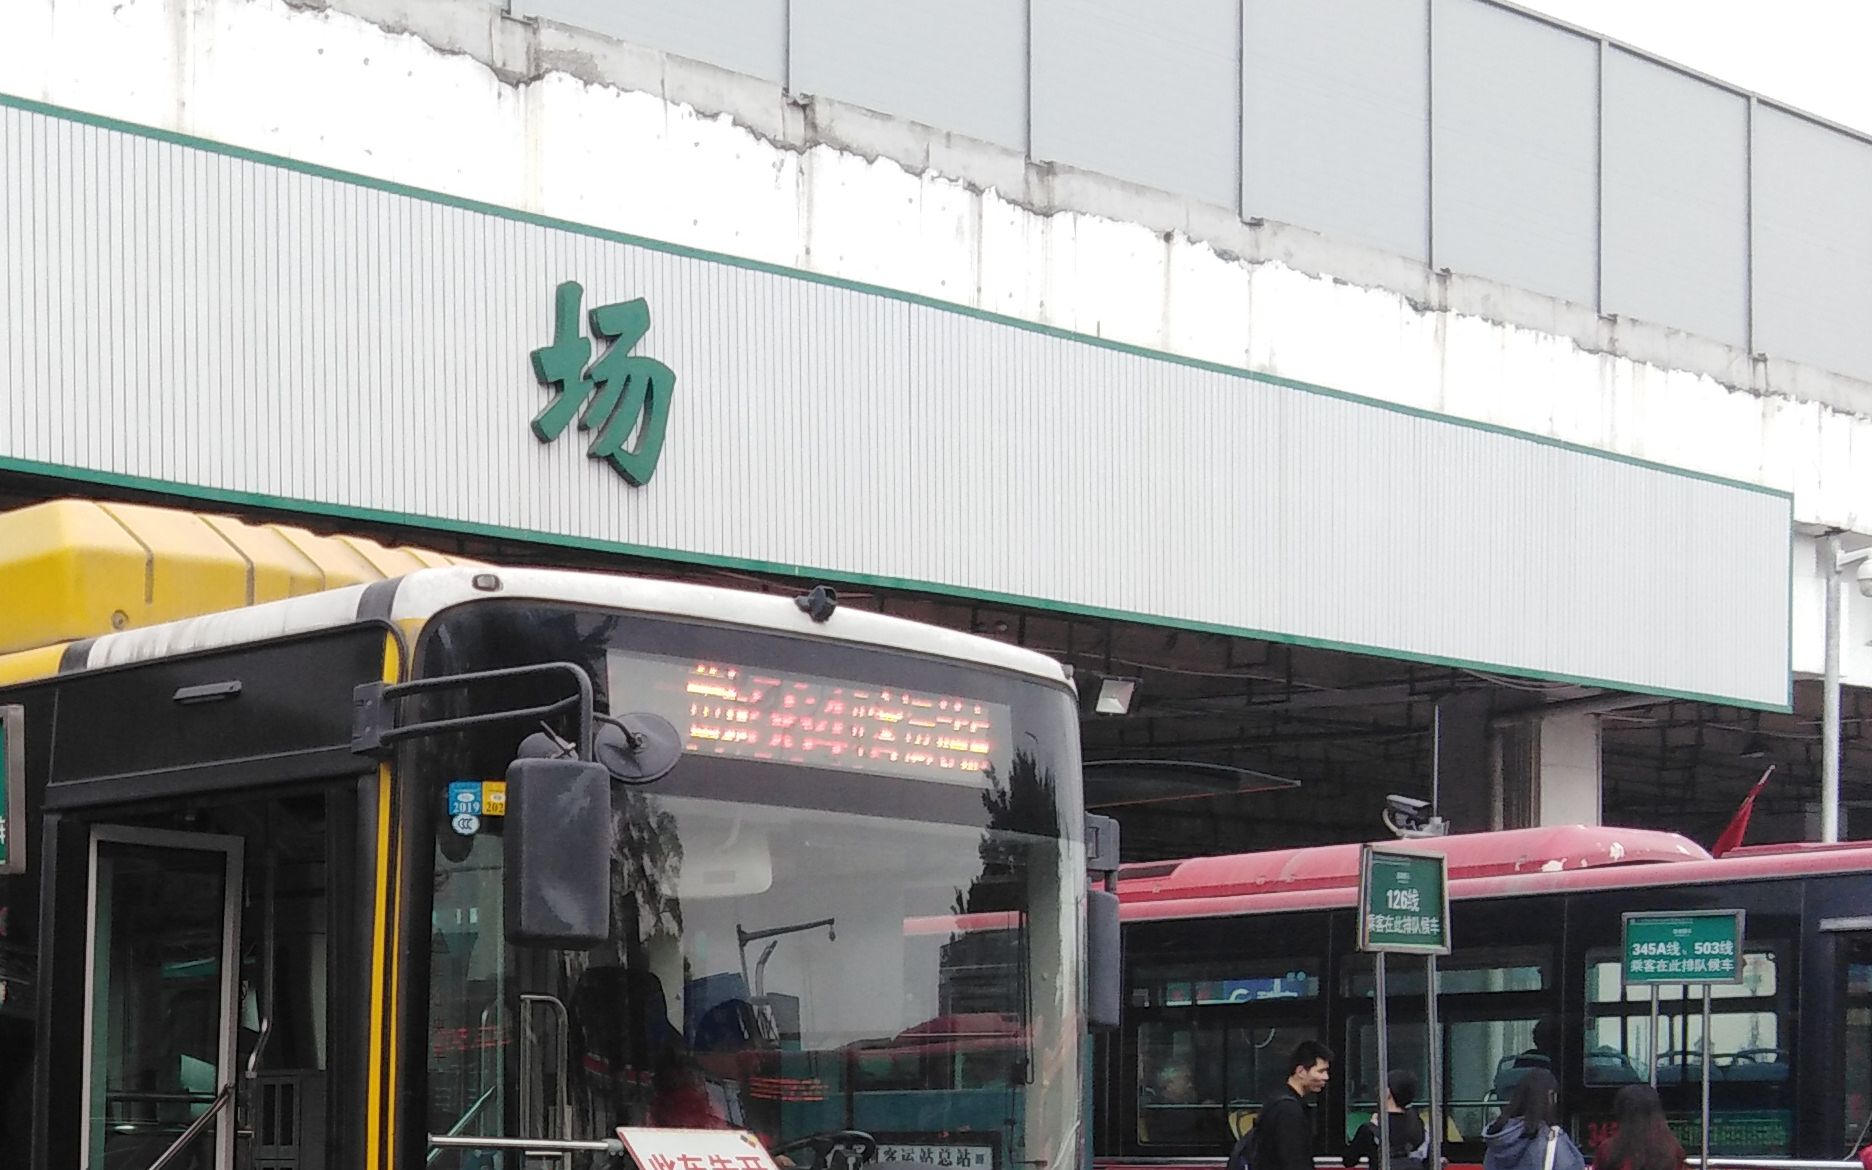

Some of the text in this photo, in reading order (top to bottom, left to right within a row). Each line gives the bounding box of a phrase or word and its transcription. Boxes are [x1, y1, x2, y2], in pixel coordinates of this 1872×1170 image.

[453, 801, 481, 814] 2019
[486, 801, 506, 814] 202
[1386, 888, 1420, 911] 126线
